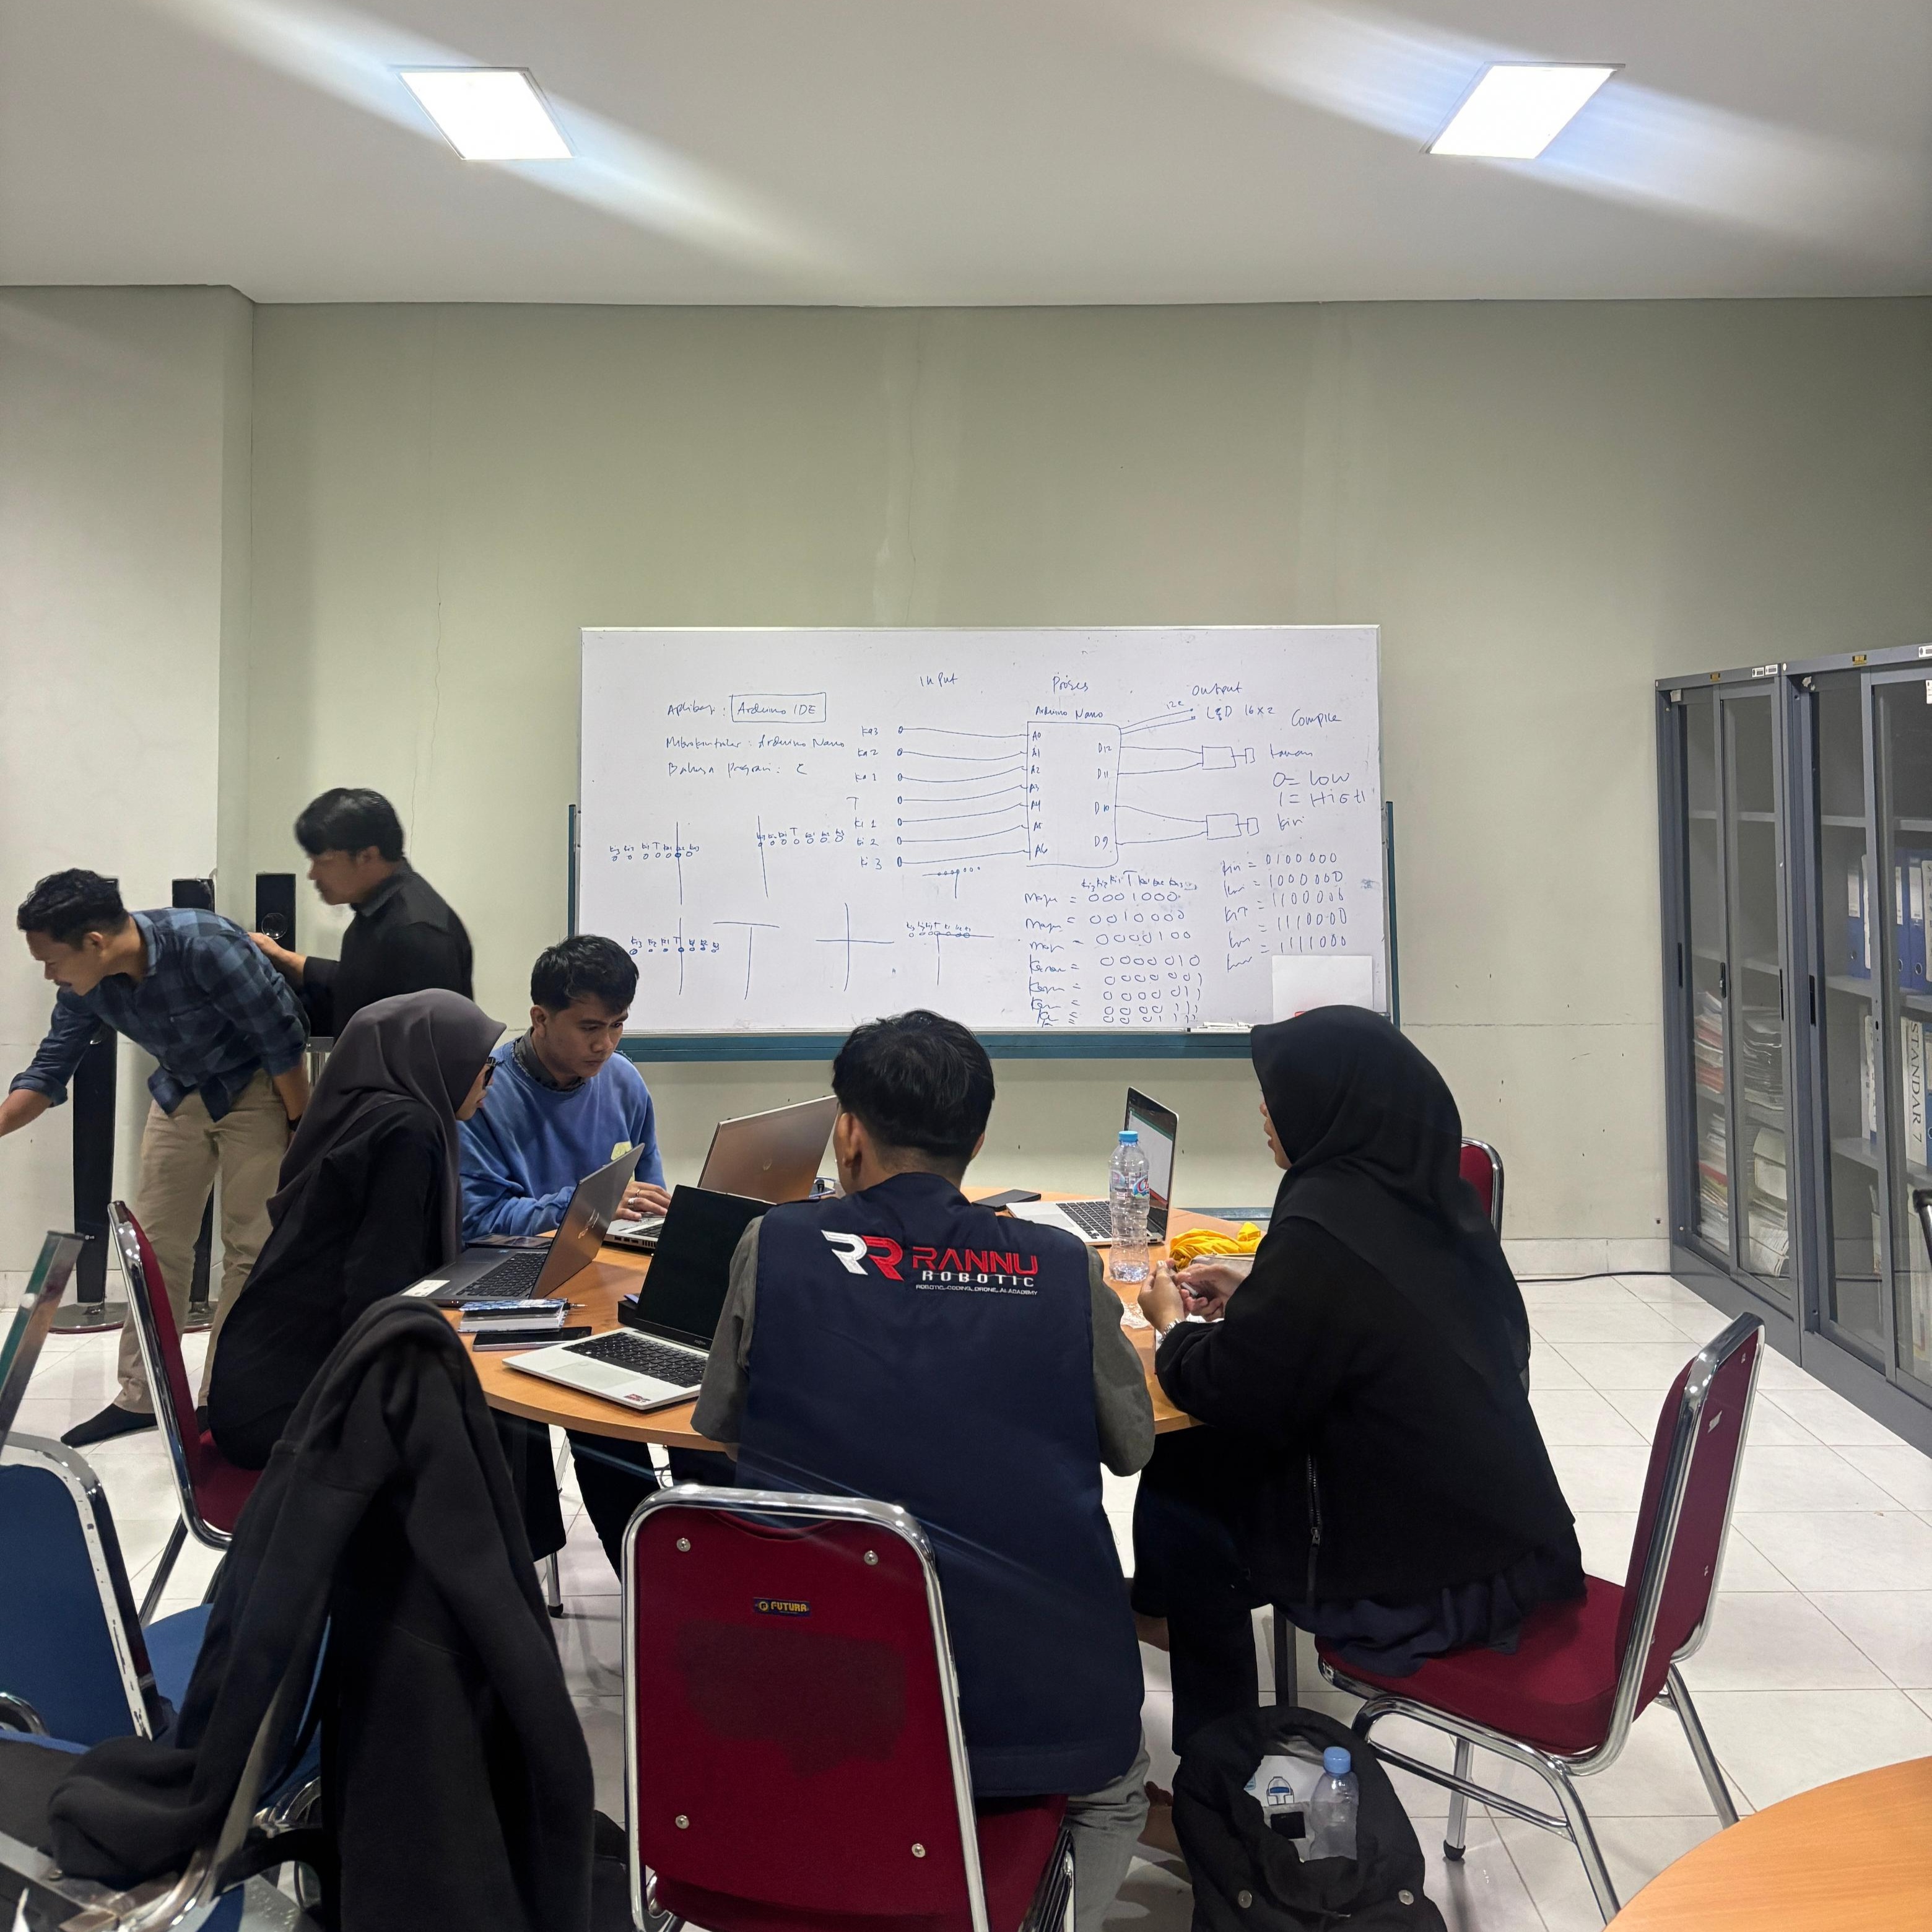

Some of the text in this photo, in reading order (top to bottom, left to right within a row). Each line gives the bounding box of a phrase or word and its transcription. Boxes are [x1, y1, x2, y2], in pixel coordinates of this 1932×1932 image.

[737, 702, 786, 715] Arduino
[794, 703, 816, 716] IDE
[1035, 705, 1103, 720] Arduino Nano
[758, 734, 806, 749] Arduino
[812, 738, 845, 748] Nano
[1032, 747, 1040, 758] A1
[1030, 764, 1040, 775] A2
[1910, 1022, 1922, 1143] STANDAR 7
[913, 1246, 1038, 1275] RANNU
[921, 1269, 1035, 1287] ROBOTIC
[770, 1601, 807, 1612] FUTURA
